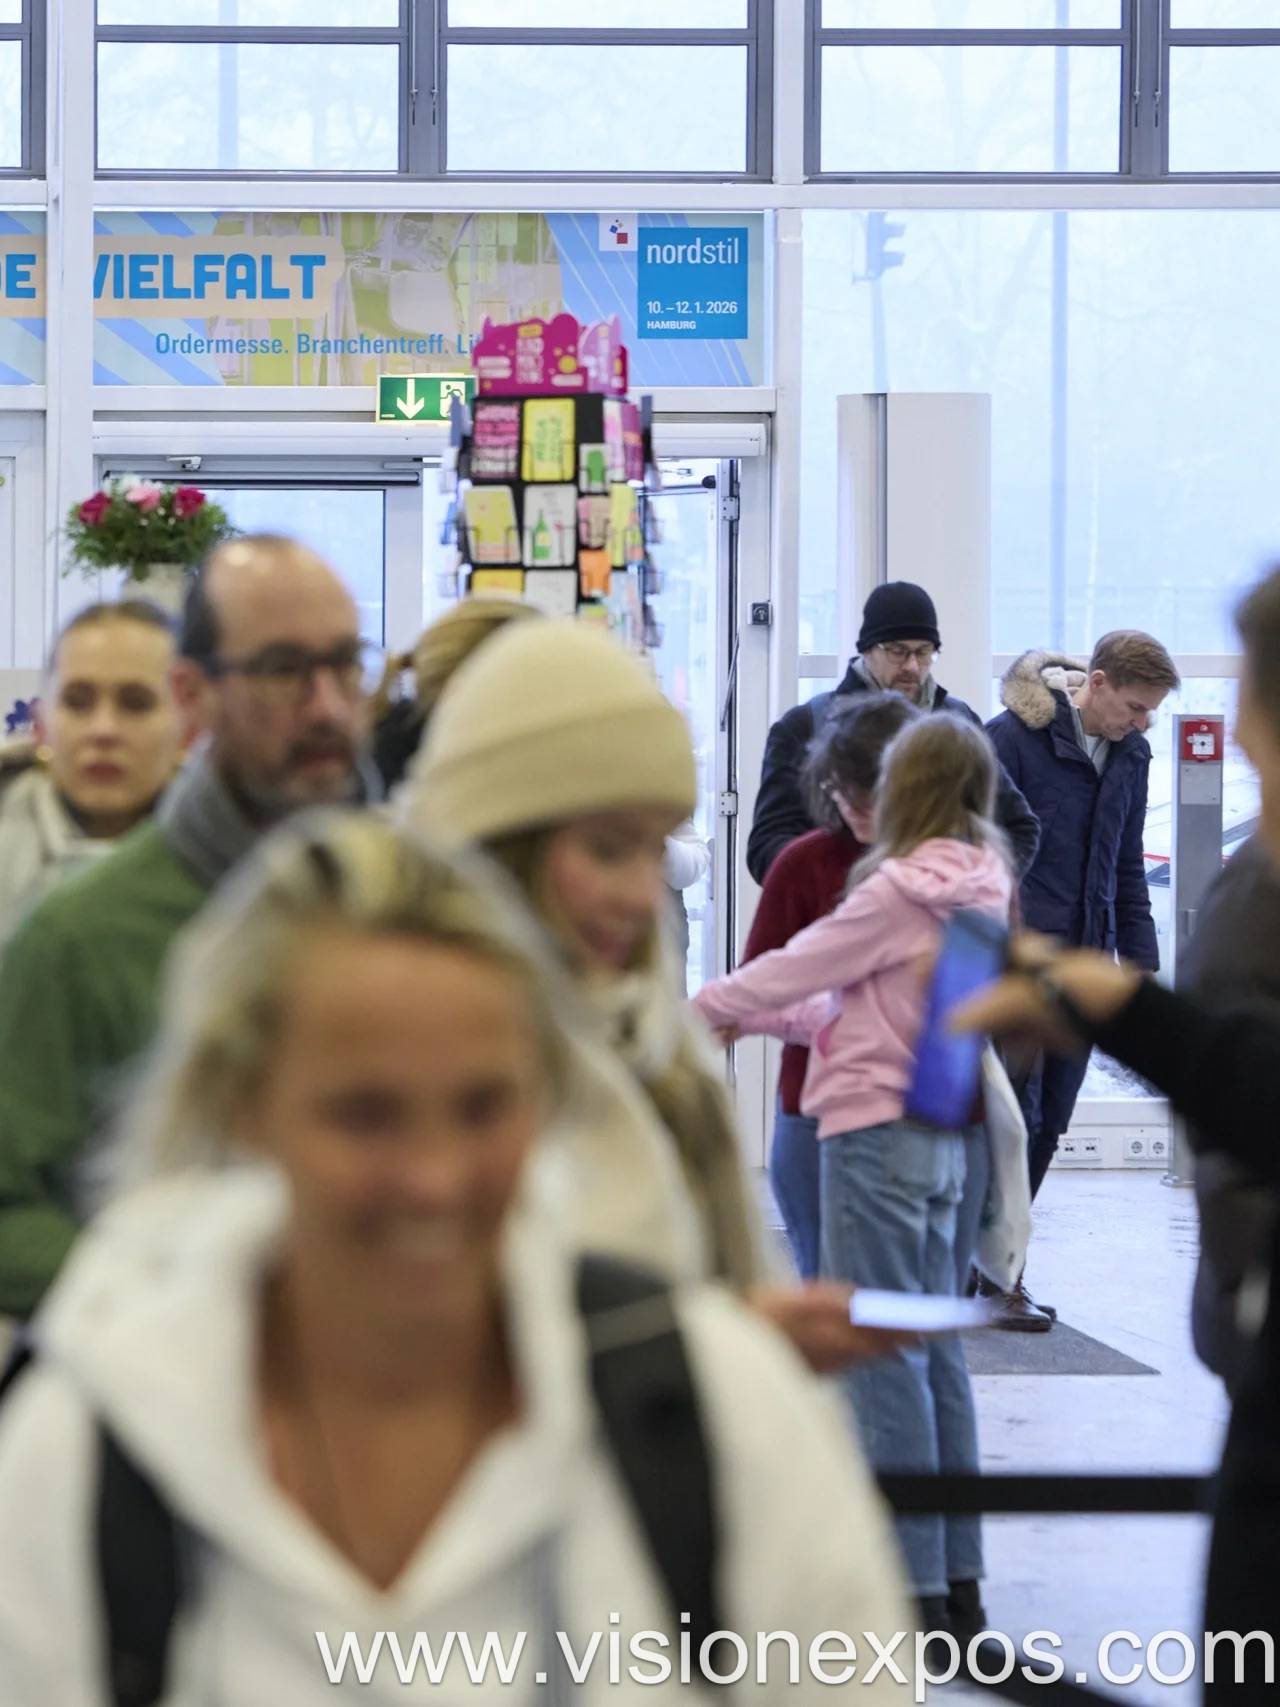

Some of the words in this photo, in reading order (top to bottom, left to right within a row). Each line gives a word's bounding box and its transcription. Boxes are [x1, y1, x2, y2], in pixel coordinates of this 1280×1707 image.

[647, 237, 739, 264] nordstil
[647, 320, 696, 329] HAMBURG
[155, 333, 288, 354] Ordermesse.
[297, 333, 448, 354] Branchentreff.
